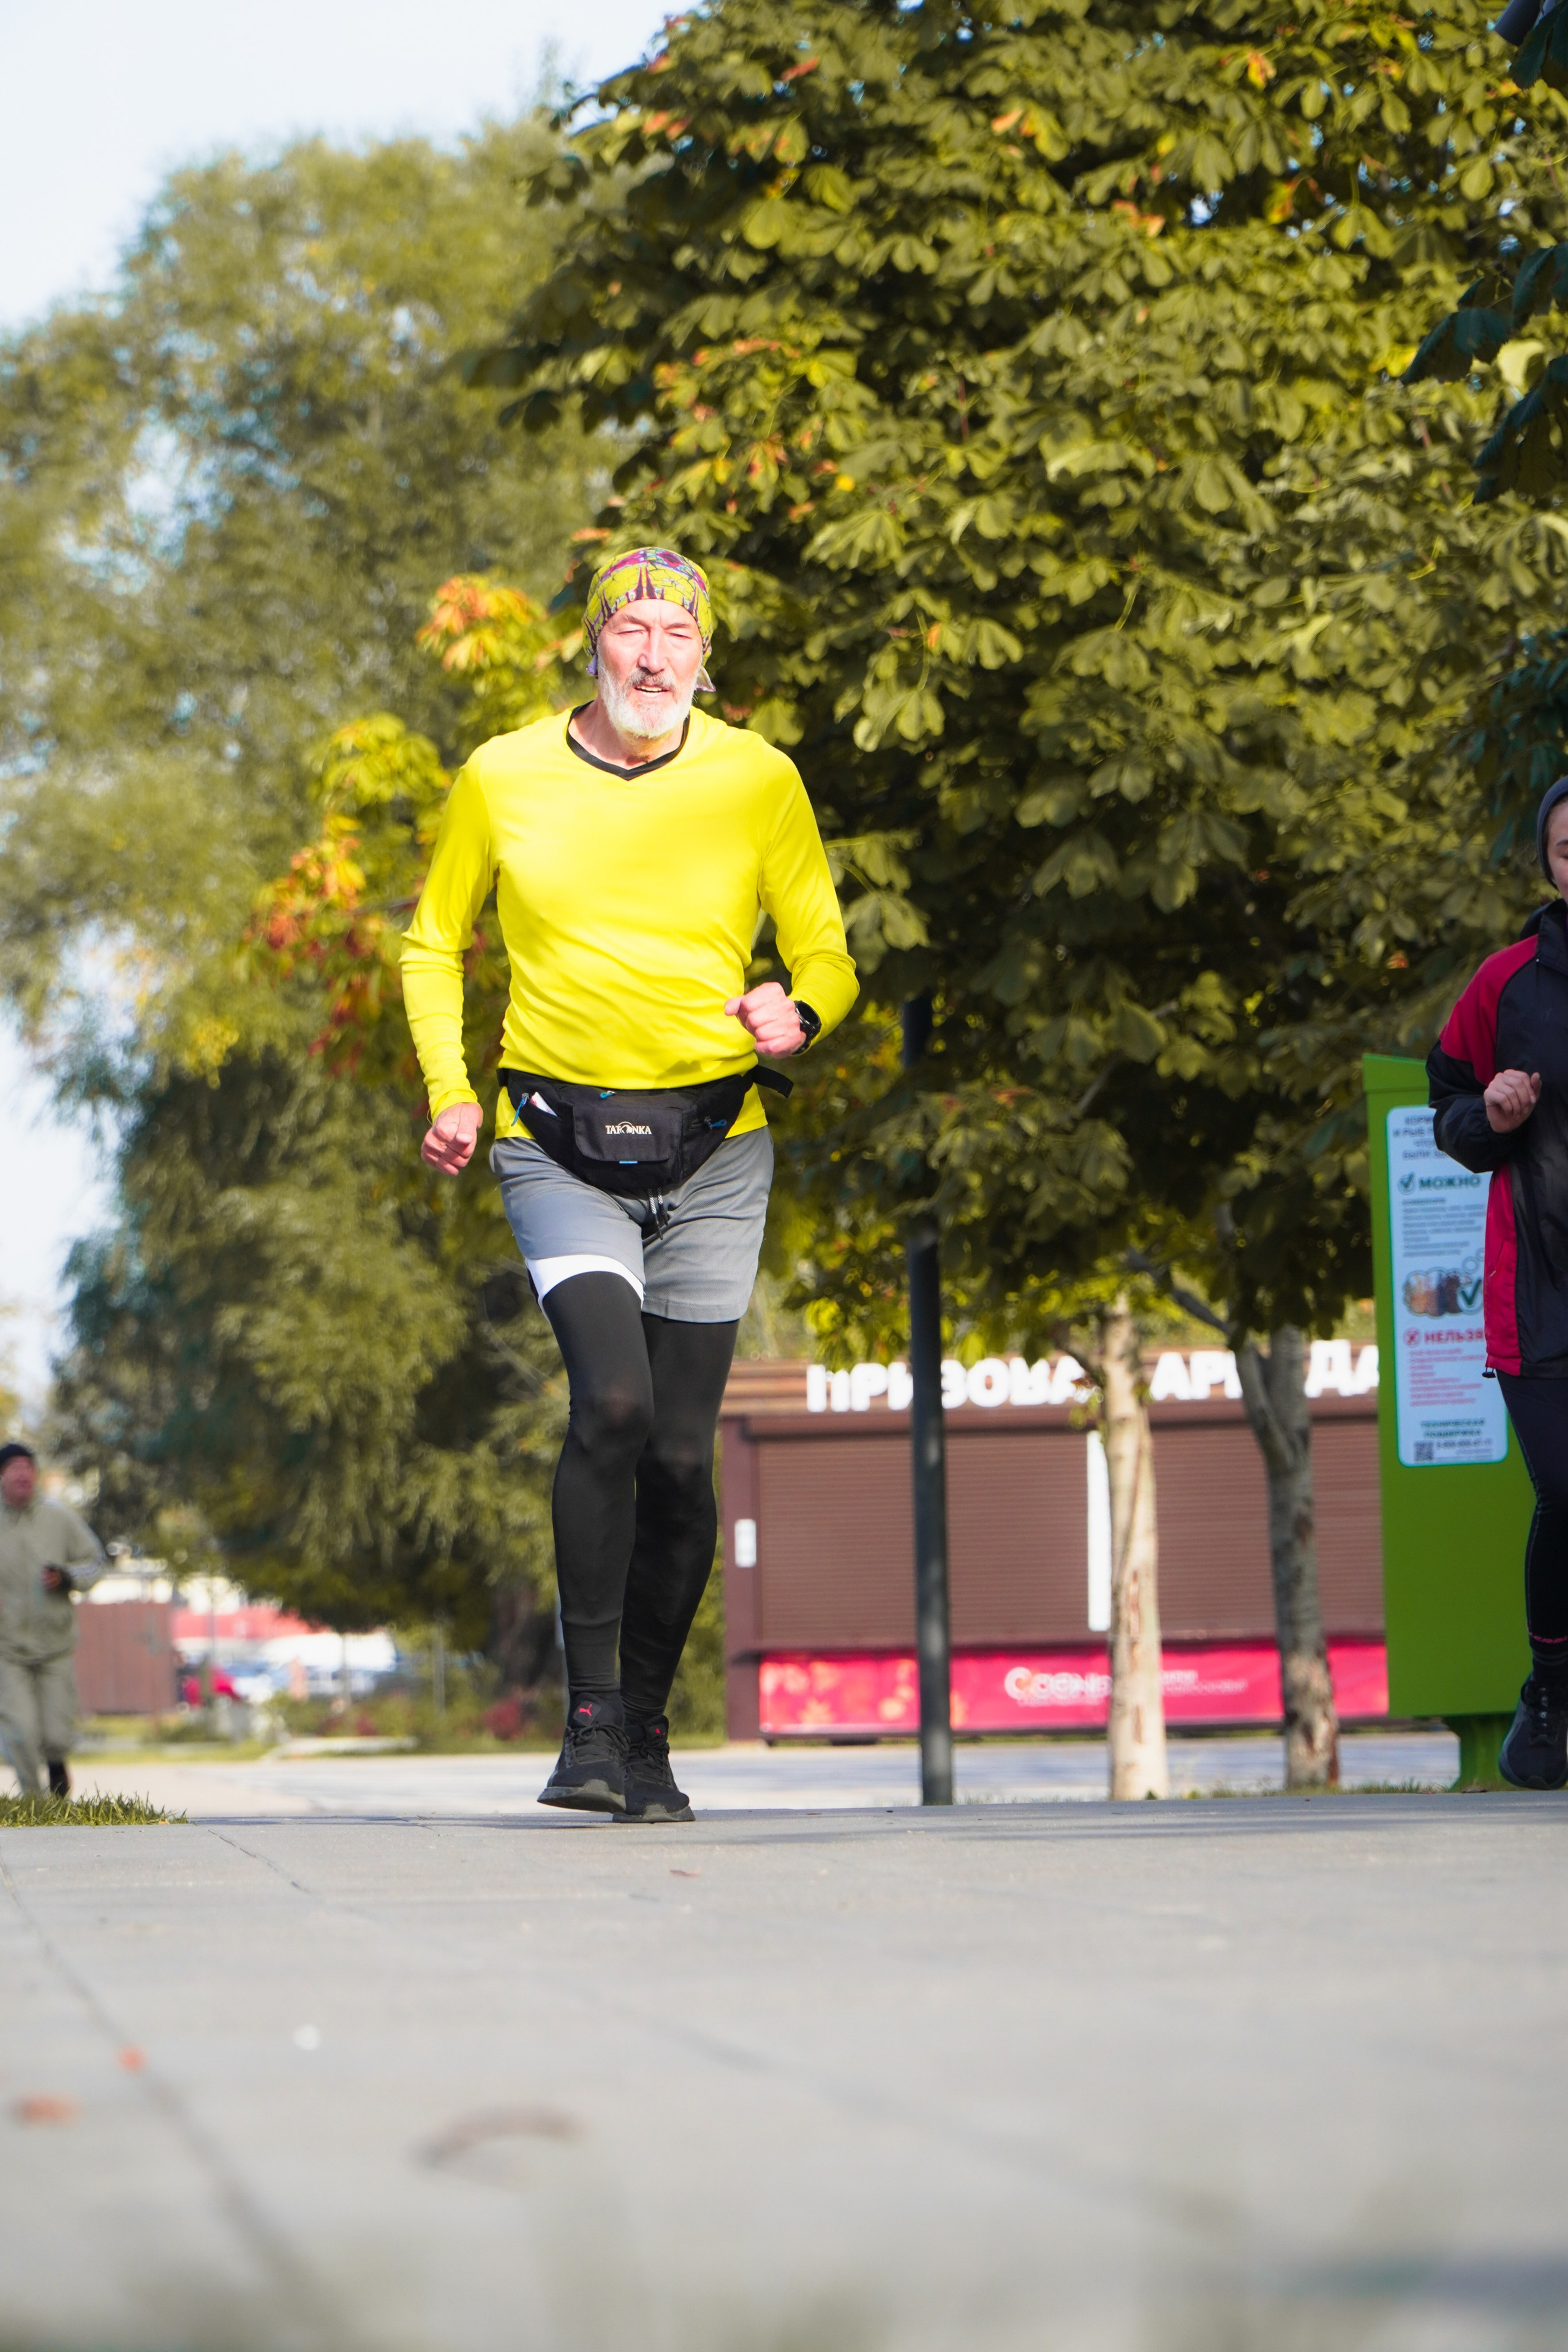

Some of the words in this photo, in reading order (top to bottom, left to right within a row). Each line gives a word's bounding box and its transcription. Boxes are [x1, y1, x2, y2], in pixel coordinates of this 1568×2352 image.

[1419, 1175, 1480, 1190] МОЖНО
[1424, 1329, 1484, 1344] НЕЛЬЗЯ
[807, 1355, 1096, 1412] ПРИЗОВА
[1150, 1340, 1379, 1400] АРДА
